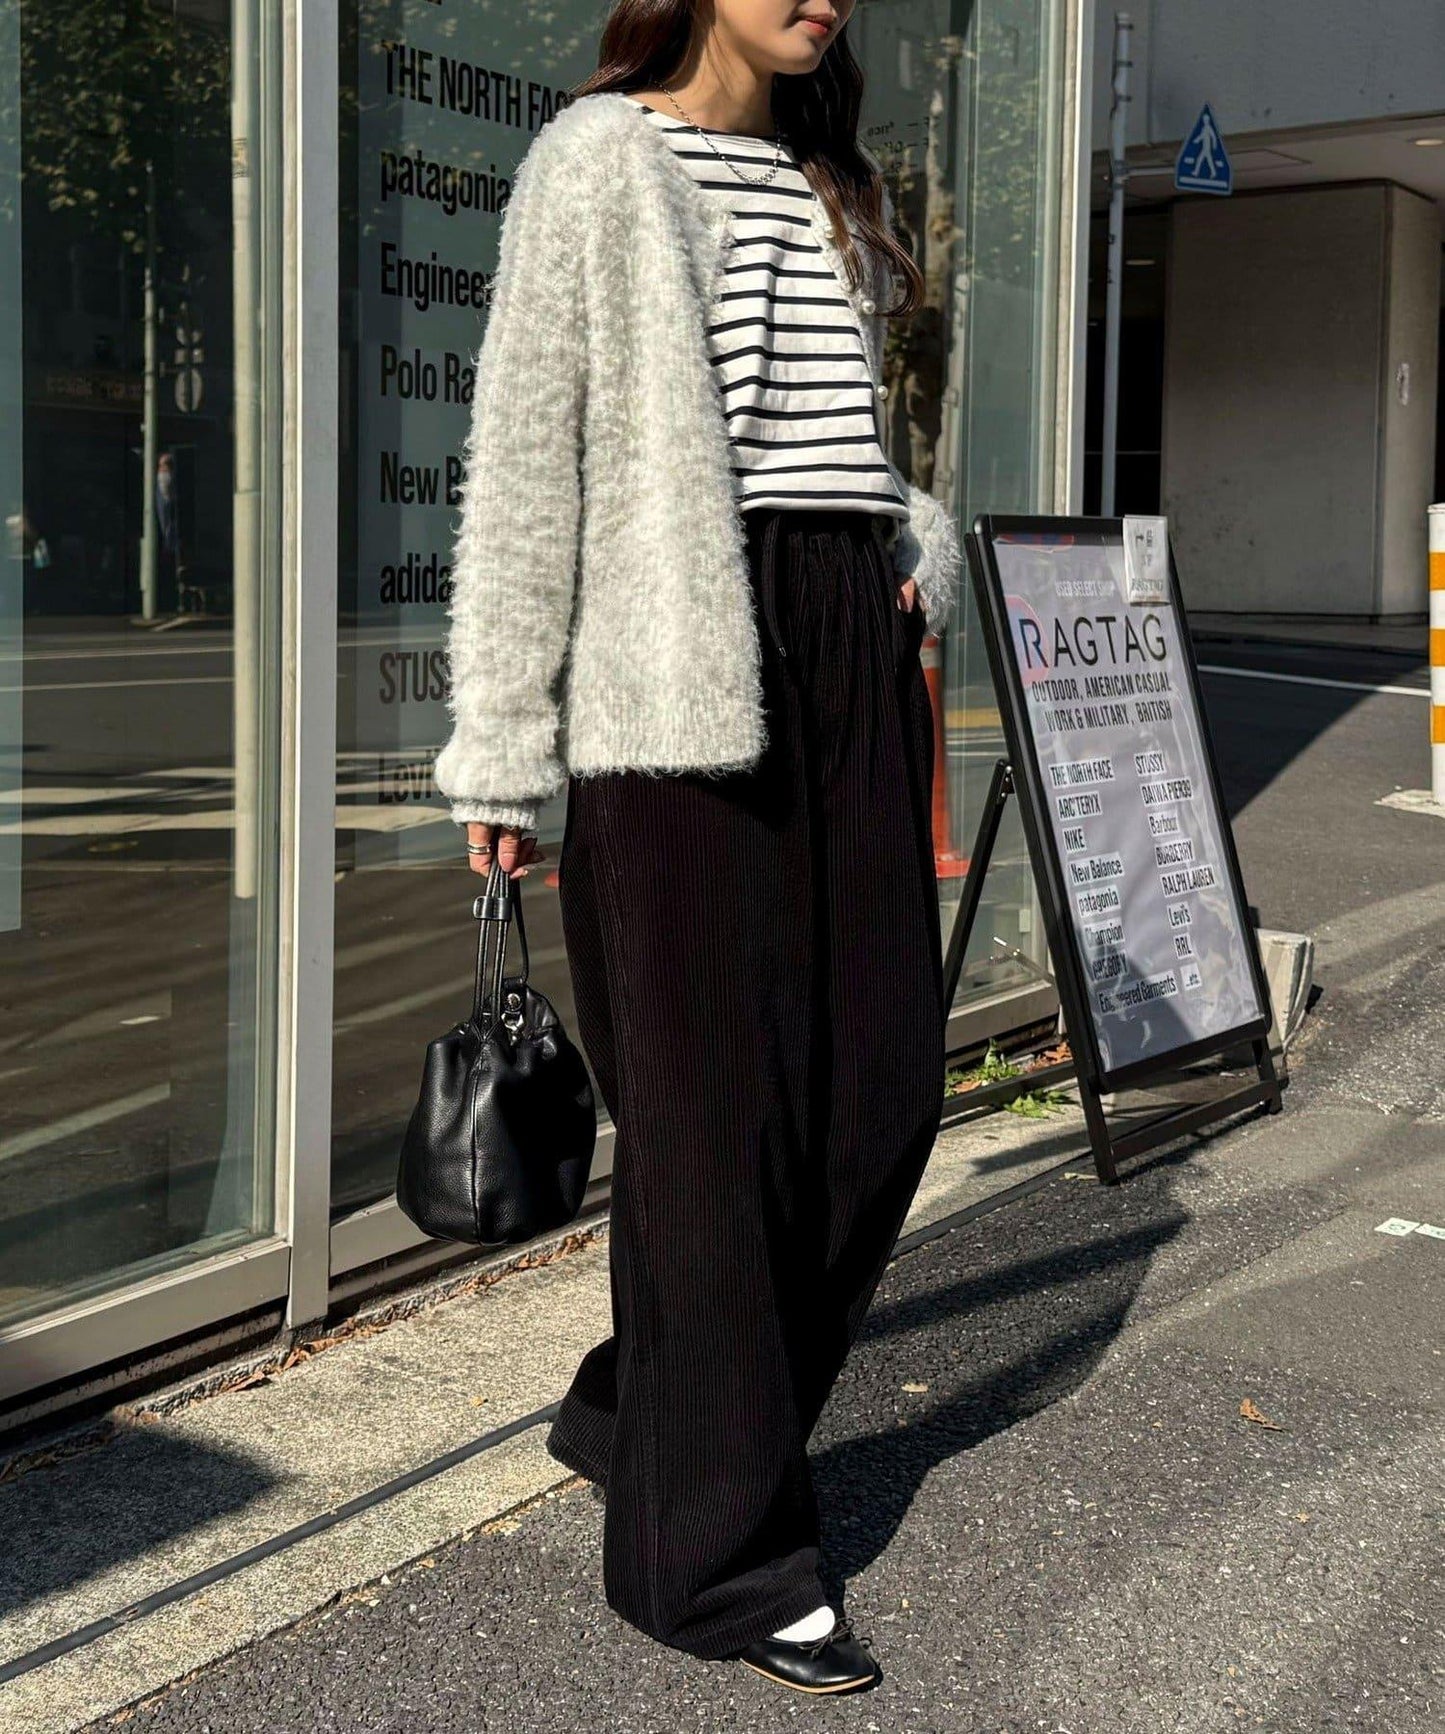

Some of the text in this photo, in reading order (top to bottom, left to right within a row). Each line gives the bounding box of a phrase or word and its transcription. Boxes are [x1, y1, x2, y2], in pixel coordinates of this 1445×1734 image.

[381, 40, 433, 105] THE
[440, 57, 521, 128] NORTH
[380, 344, 437, 401] Polo
[380, 451, 439, 504] New
[1018, 614, 1167, 669] RAGTAG
[1032, 672, 1171, 702] OUTDOOR, AMERICAN CASUAL
[1045, 708, 1076, 732] WORK
[1075, 708, 1084, 728] &
[1135, 700, 1172, 723] BRITISH
[1050, 760, 1113, 786] THE NORTH FACE
[1135, 753, 1165, 774] STUSSY
[1142, 779, 1192, 804] DAIWA PIER39
[1064, 829, 1085, 850] NIKE
[1070, 859, 1122, 882] New Balance
[1161, 868, 1215, 896] RALPH LAUREN
[1078, 888, 1119, 916] patagonia
[1175, 936, 1192, 957] RRL
[1141, 975, 1176, 1000] Garments
